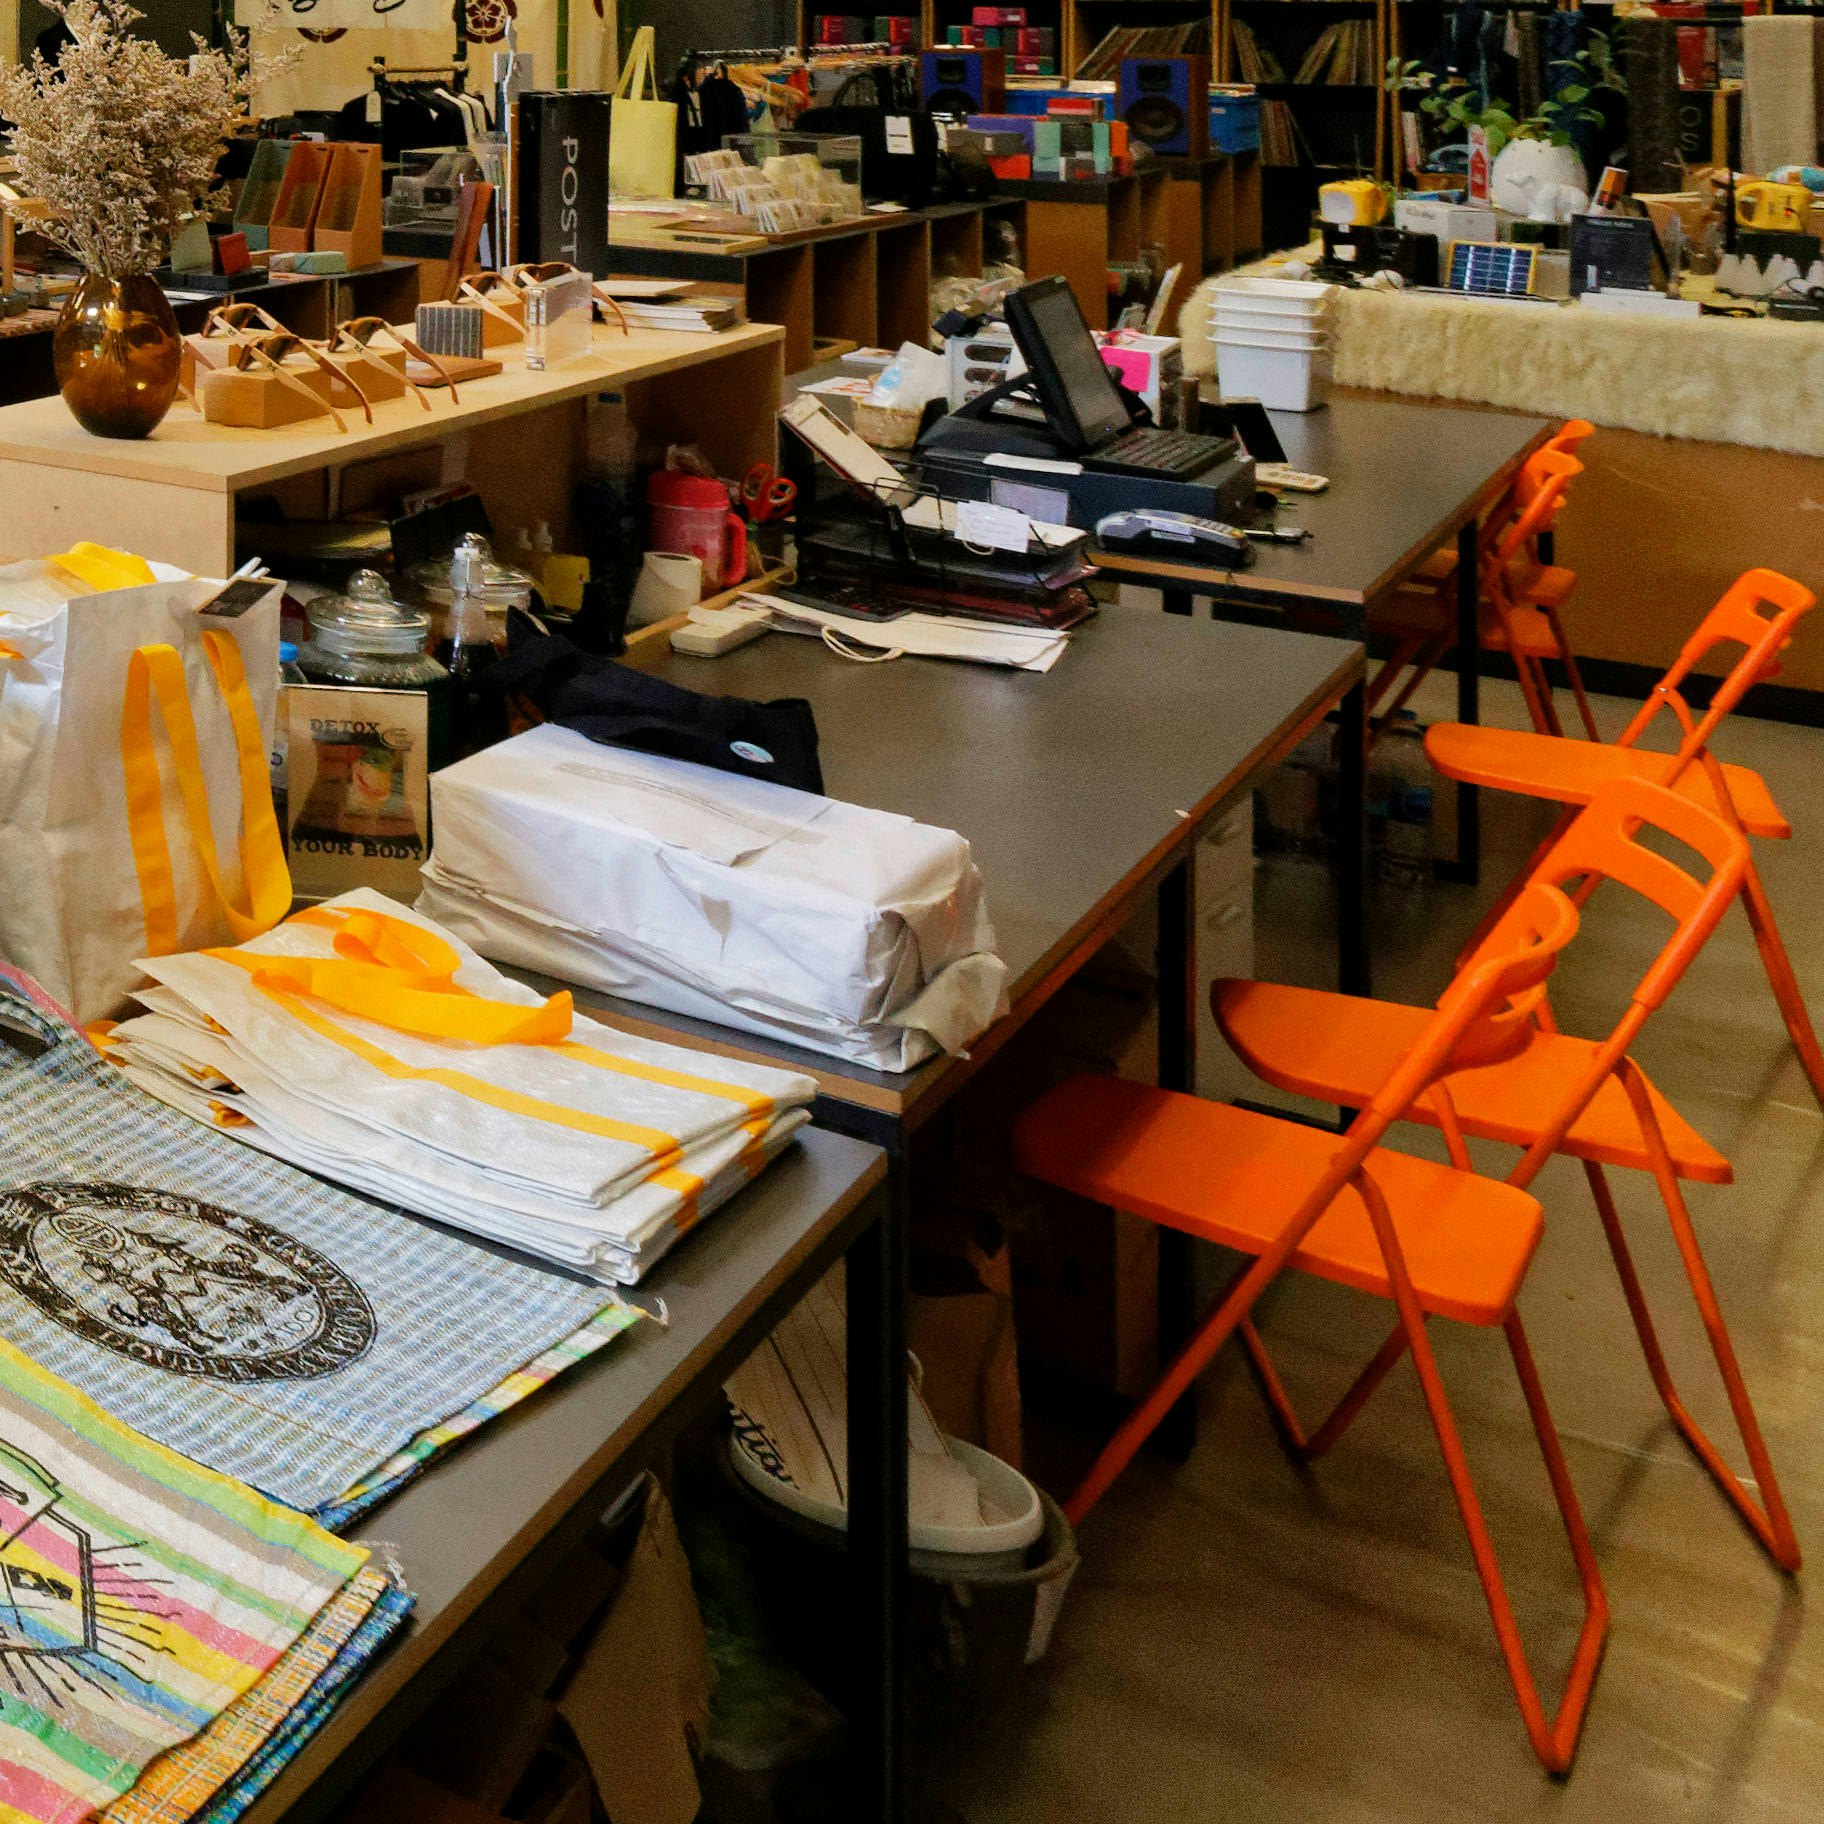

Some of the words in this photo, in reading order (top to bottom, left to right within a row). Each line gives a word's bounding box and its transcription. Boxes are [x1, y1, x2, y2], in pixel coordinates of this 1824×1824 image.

[560, 135, 579, 265] POST
[309, 718, 381, 735] DETOX
[292, 837, 355, 857] YOUR
[362, 841, 422, 861] BODY
